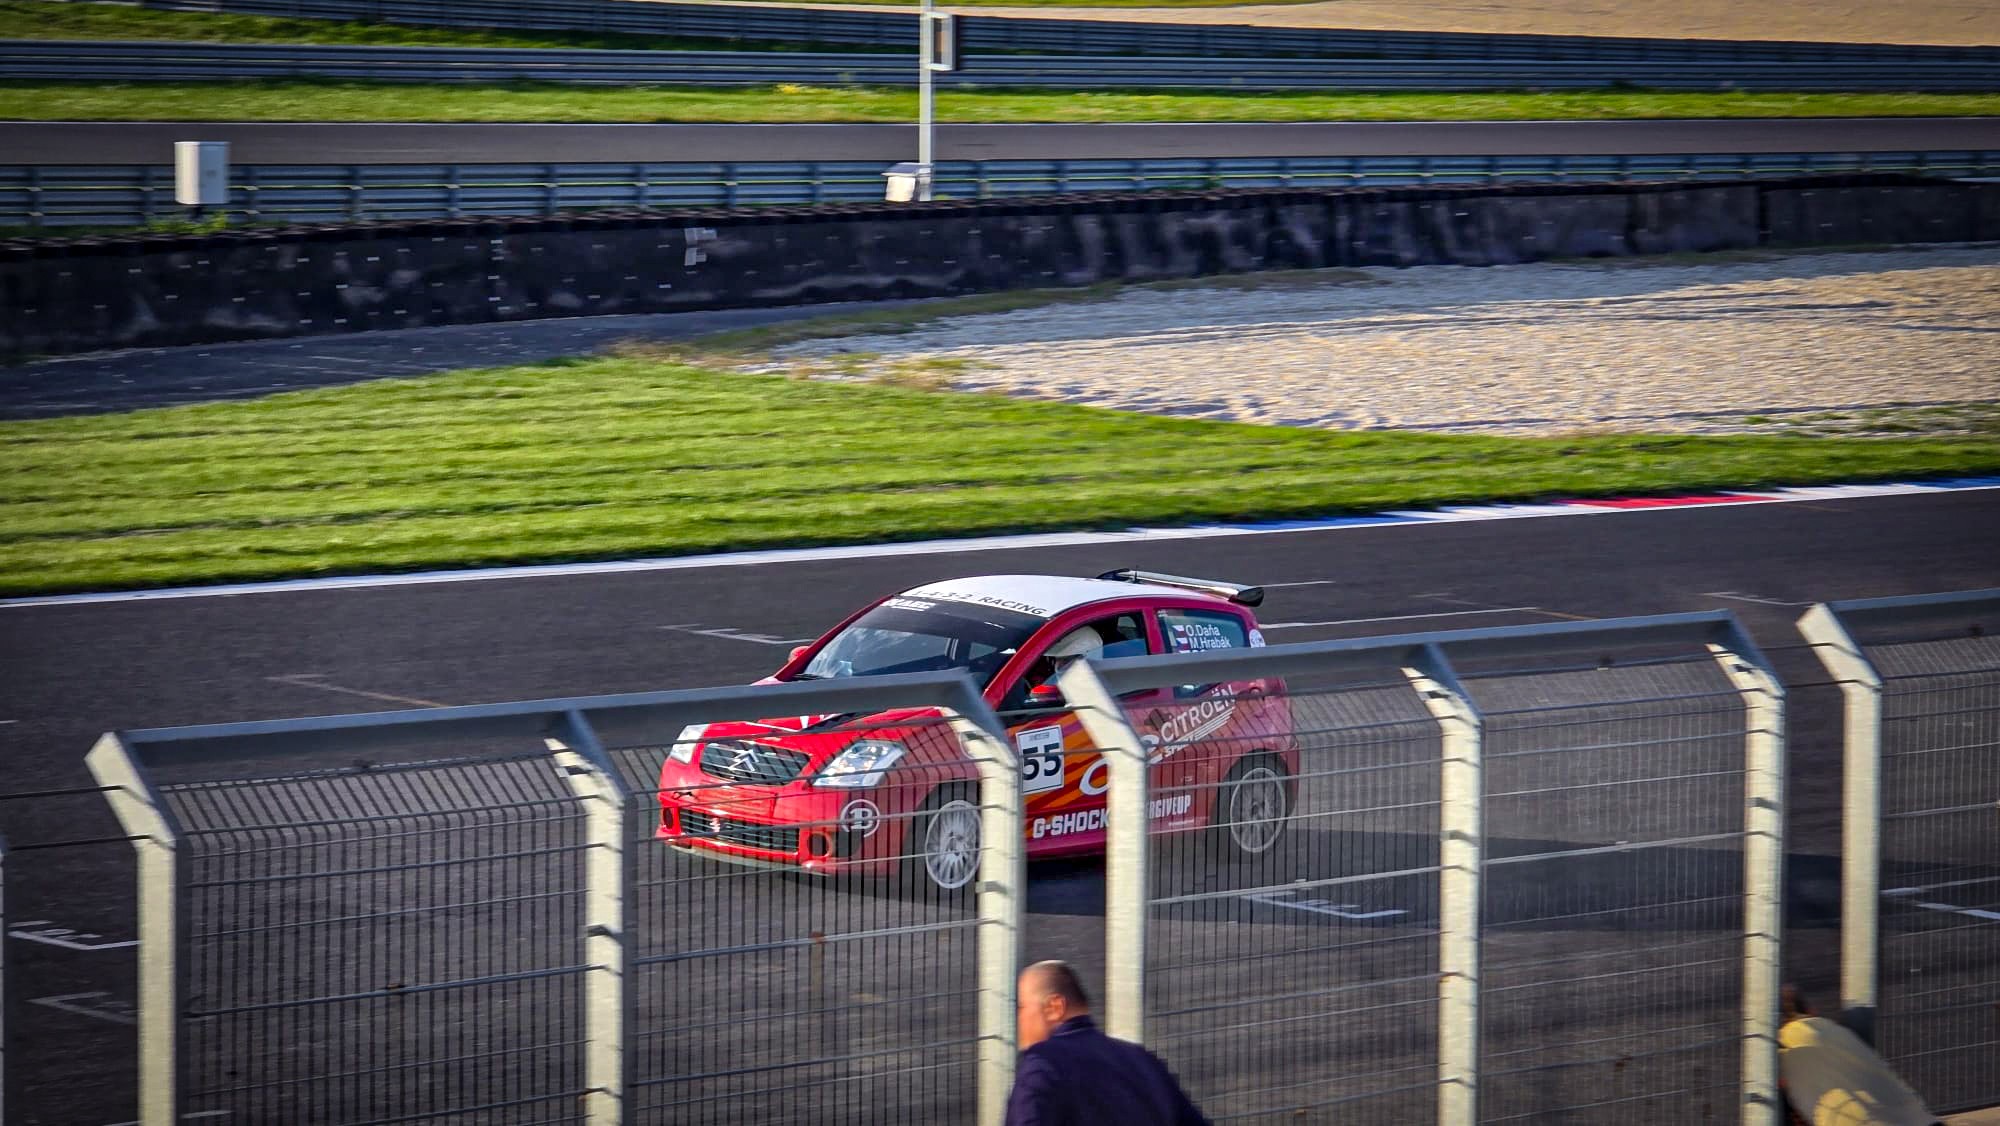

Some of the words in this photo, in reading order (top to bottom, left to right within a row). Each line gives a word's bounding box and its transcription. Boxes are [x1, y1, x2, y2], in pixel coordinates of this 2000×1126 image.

[977, 595, 1048, 616] RACING
[1185, 624, 1221, 637] O.Daňa
[1188, 636, 1232, 649] M.Hrabák
[1160, 684, 1236, 743] CITROËN
[1022, 742, 1062, 781] 55
[1032, 807, 1110, 839] G-SHOCK
